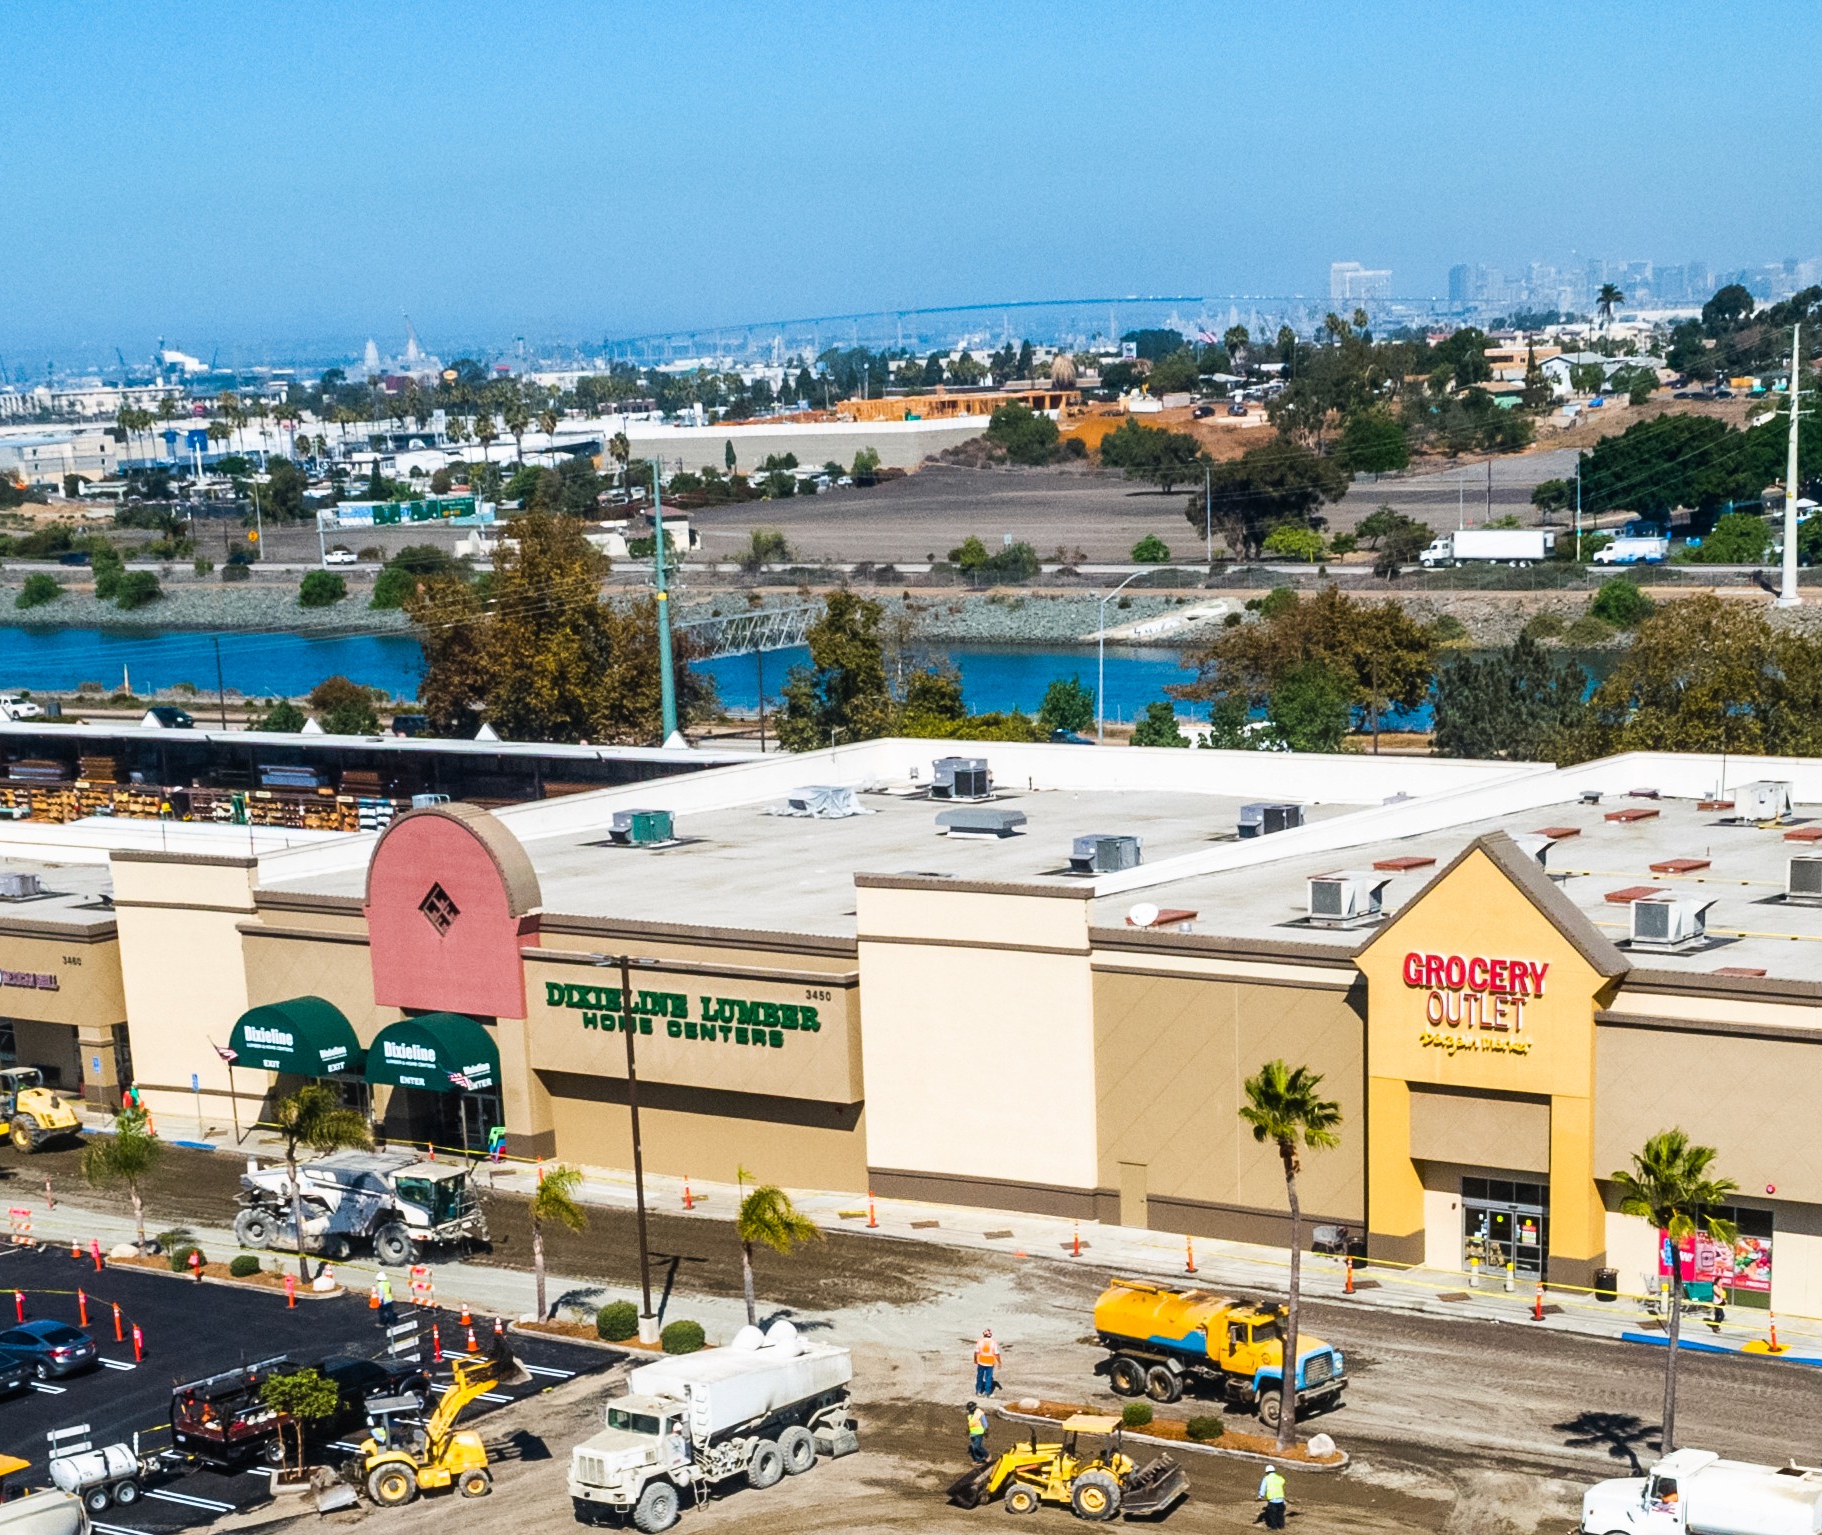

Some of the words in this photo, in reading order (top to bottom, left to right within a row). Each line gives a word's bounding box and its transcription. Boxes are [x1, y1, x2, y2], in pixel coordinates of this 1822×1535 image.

[1402, 952, 1550, 998] GROCERY
[545, 981, 689, 1019] DIXIELINE
[700, 996, 821, 1032] LUMBER
[805, 989, 832, 1002] 3450
[1426, 990, 1526, 1033] OUTLET
[243, 1025, 294, 1047] Dixieline
[667, 1019, 785, 1048] CENTERS
[383, 1040, 436, 1062] Dixieline
[262, 1059, 280, 1068] EXIT
[327, 1061, 346, 1073] EXIT
[399, 1075, 426, 1087] ENTER
